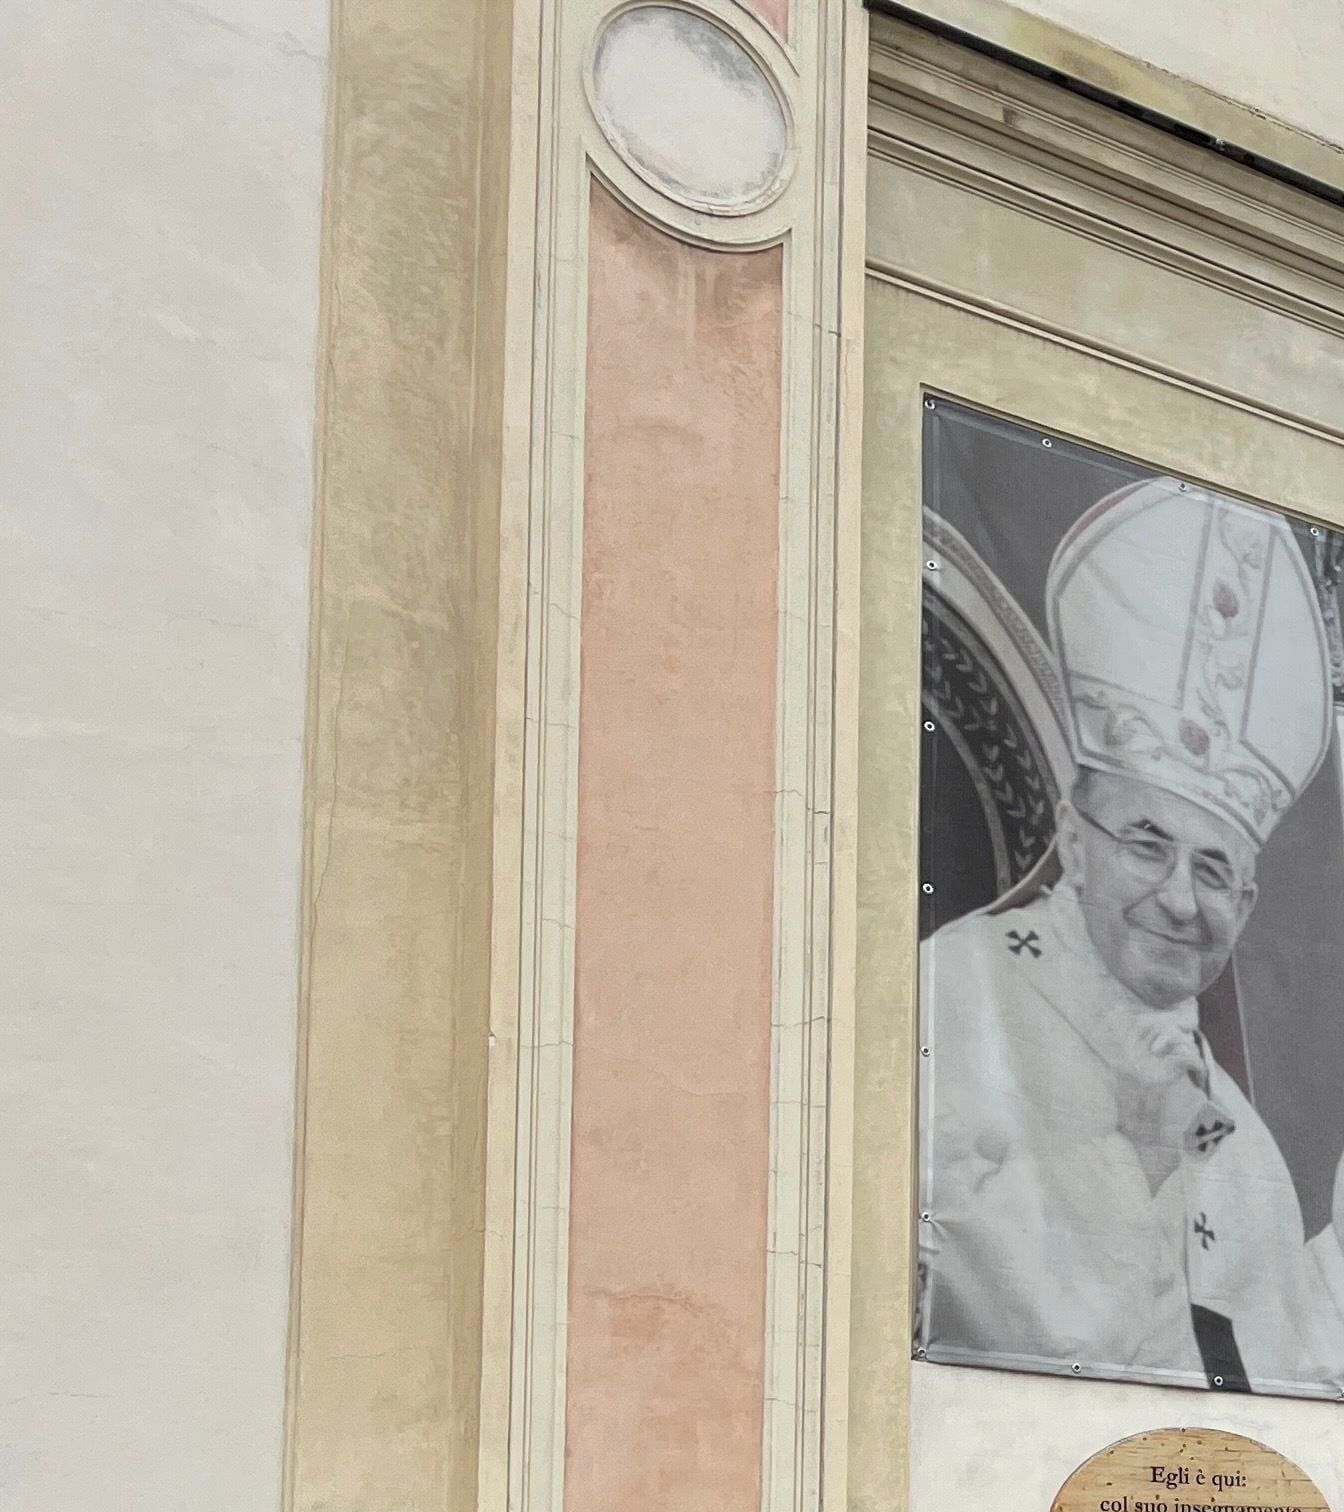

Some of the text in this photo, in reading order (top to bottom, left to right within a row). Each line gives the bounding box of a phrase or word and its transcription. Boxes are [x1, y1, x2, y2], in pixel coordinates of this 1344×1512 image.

[1151, 1466, 1247, 1492] Egli è qui:
[1100, 1496, 1128, 1512] col
